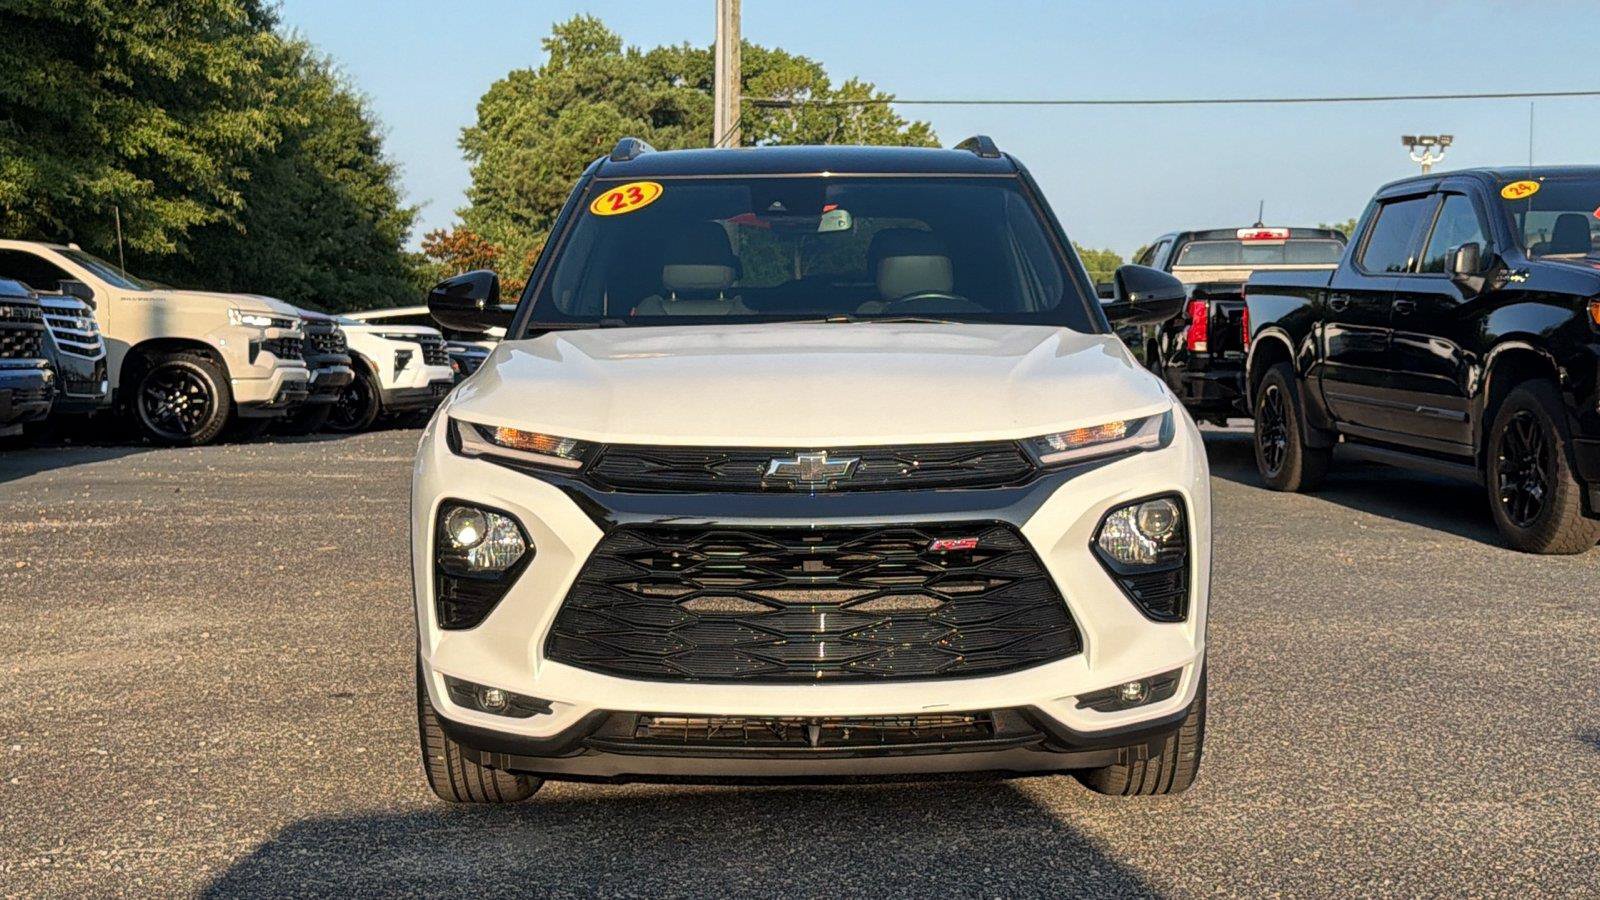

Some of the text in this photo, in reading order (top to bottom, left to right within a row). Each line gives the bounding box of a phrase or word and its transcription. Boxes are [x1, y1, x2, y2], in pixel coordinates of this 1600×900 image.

[1508, 183, 1532, 196] 24
[607, 186, 645, 211] 23
[929, 537, 979, 551] RS
